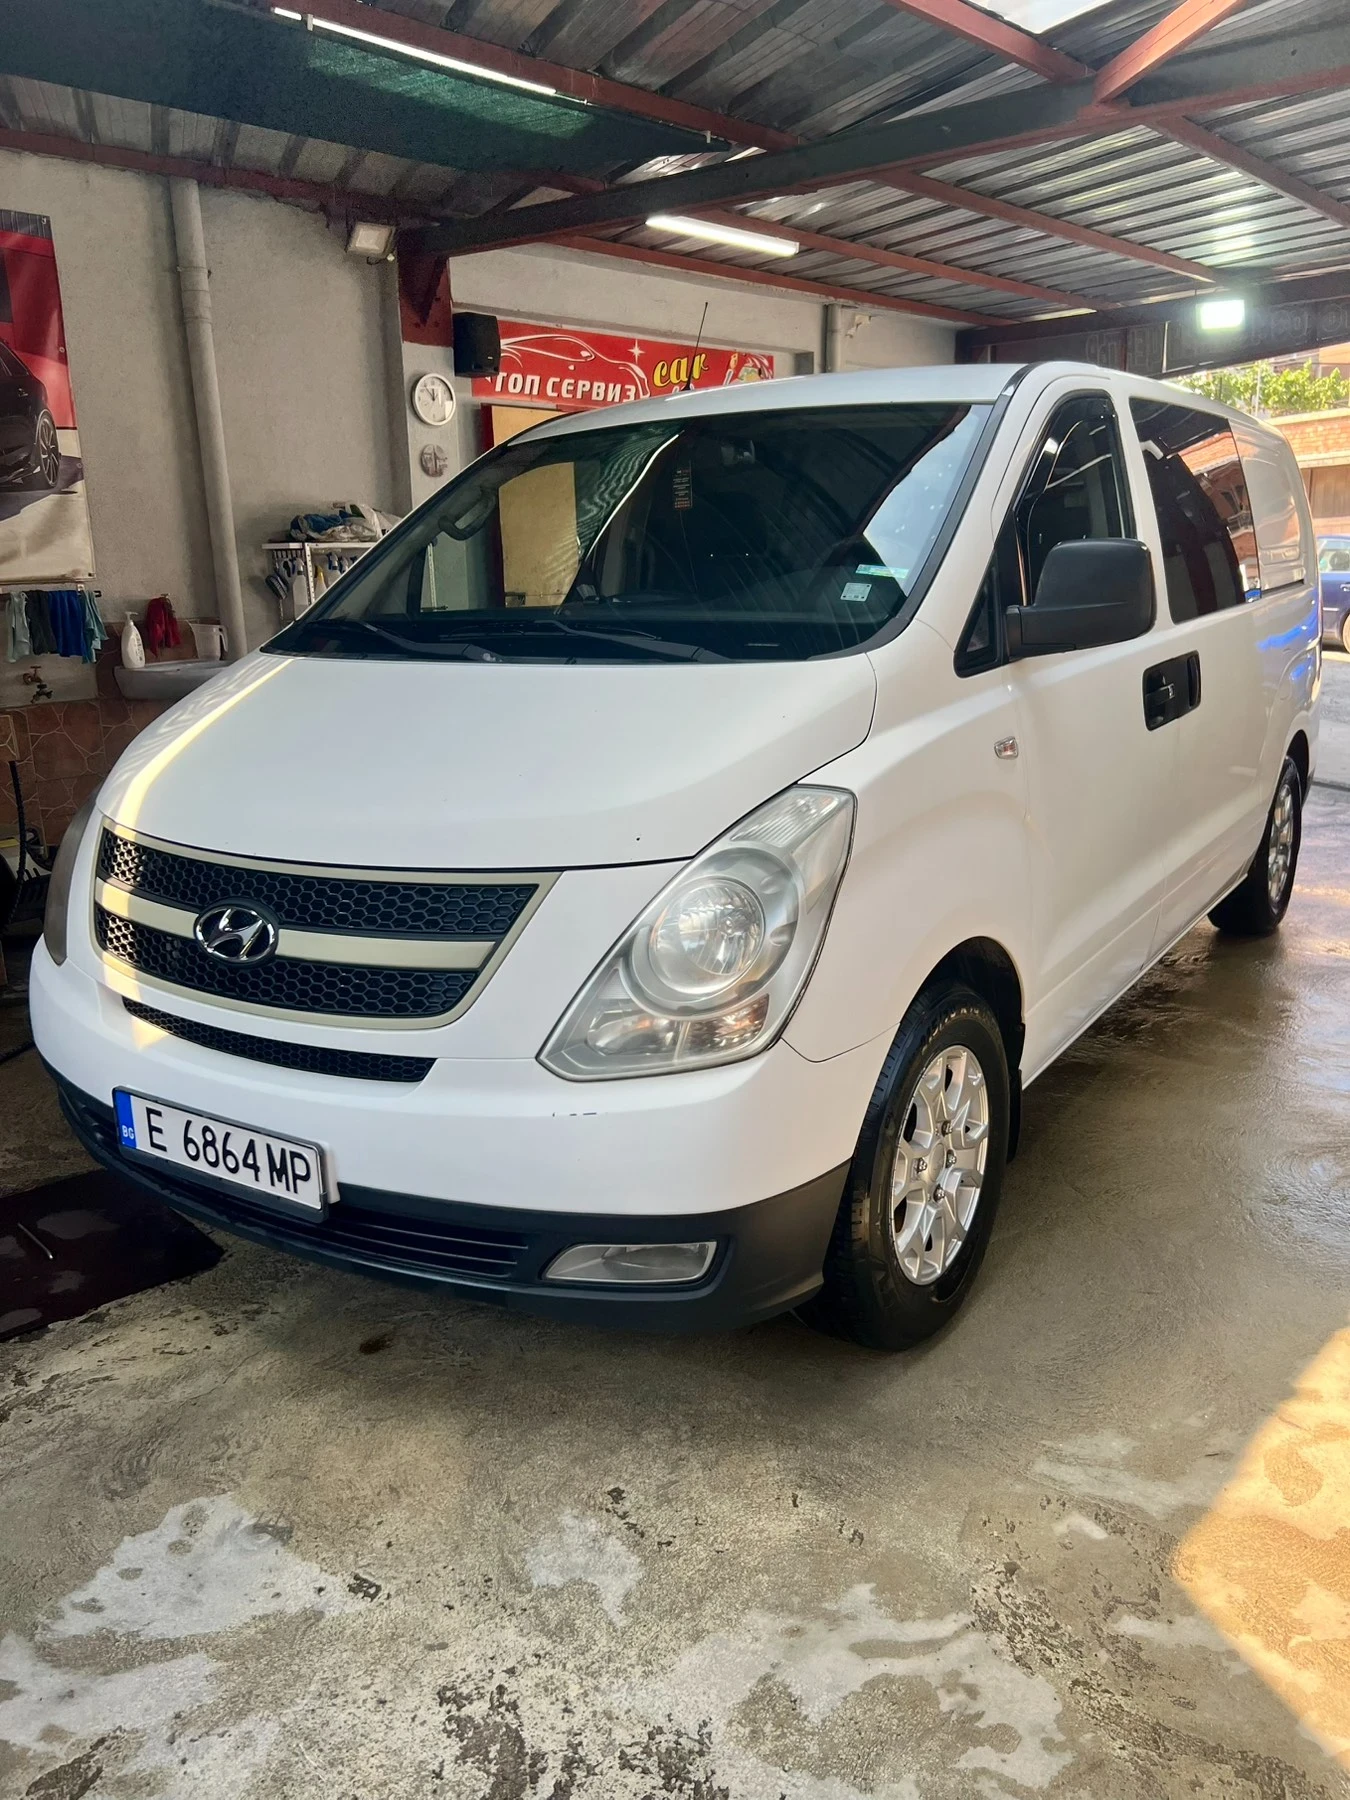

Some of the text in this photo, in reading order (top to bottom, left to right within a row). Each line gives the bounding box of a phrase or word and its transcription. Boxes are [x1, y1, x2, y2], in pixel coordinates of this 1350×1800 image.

[653, 353, 709, 388] car
[546, 376, 637, 403] СЕРВИЗ
[121, 1124, 135, 1140] BG
[146, 1106, 311, 1194] E 6864 MP
